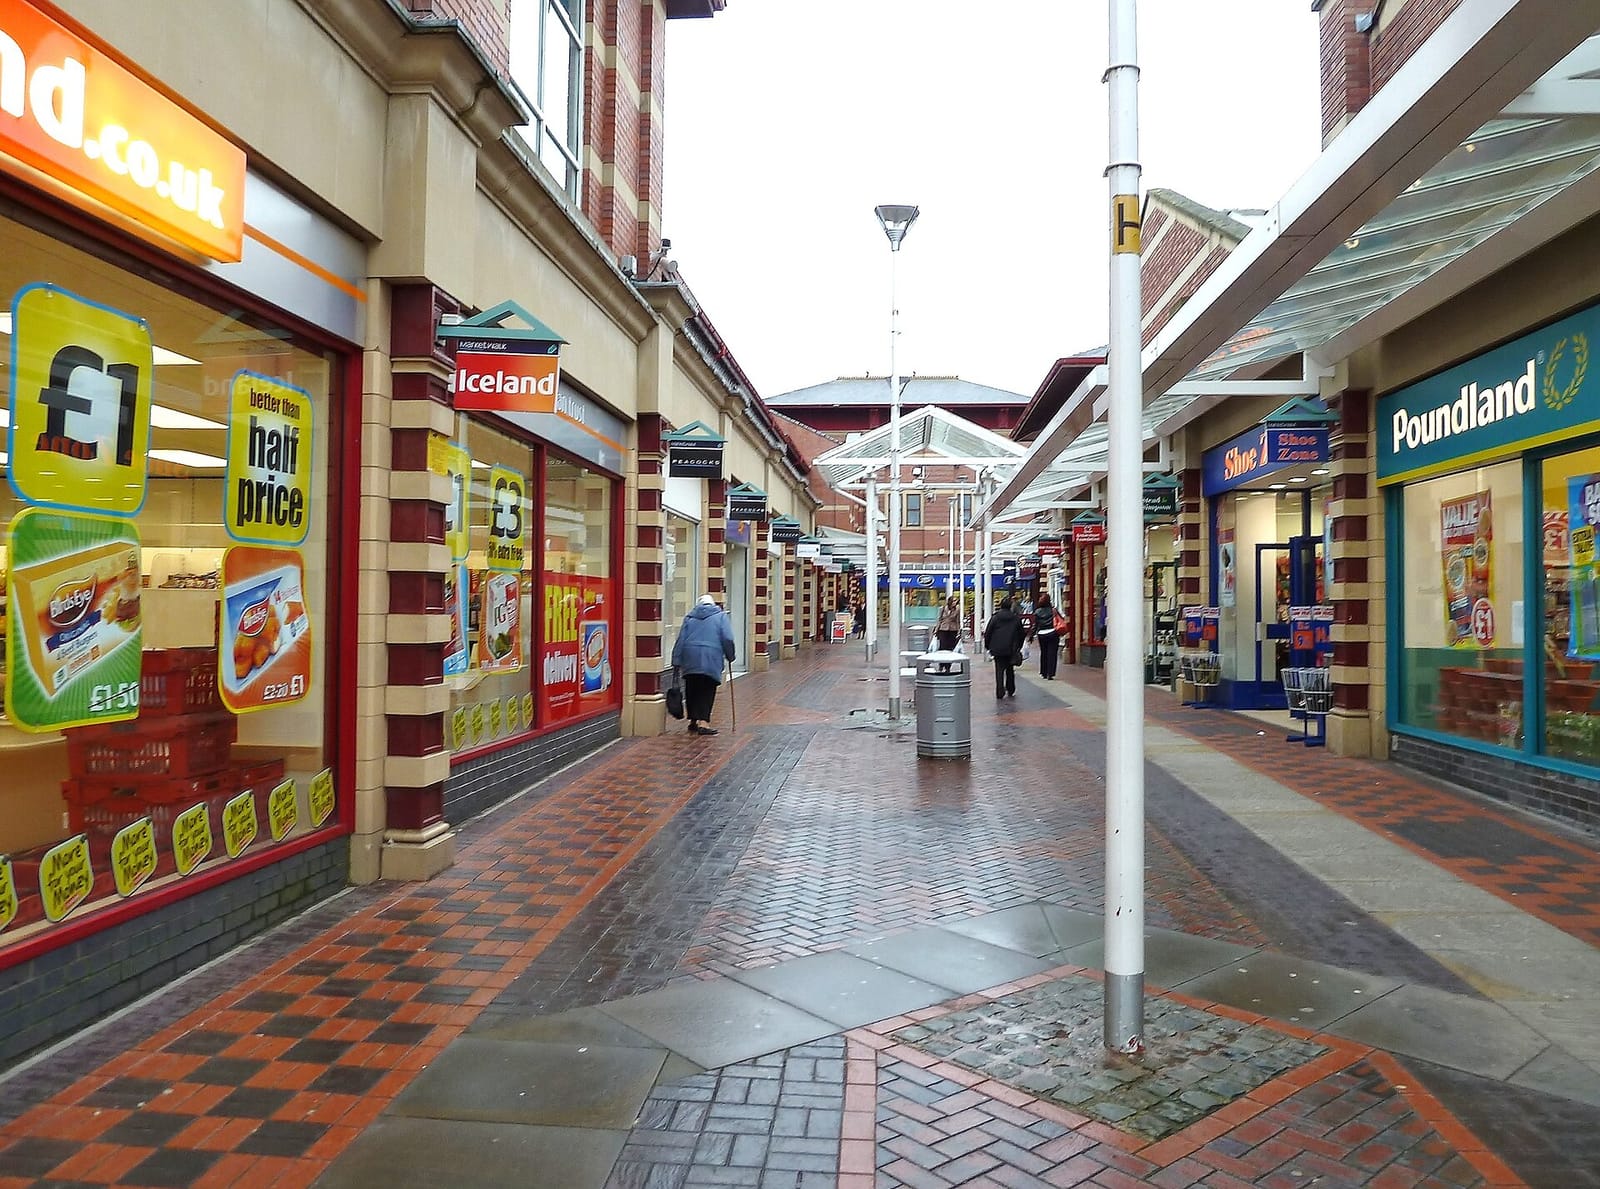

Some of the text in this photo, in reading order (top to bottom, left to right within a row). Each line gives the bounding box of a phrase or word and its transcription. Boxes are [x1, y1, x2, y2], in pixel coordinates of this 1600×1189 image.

[459, 368, 556, 396] Iceland
[35, 344, 139, 467] £1
[250, 387, 300, 420] better than
[1392, 358, 1537, 454] Poundland
[249, 415, 300, 475] half
[1277, 447, 1320, 461] Zone
[1278, 433, 1318, 446] Shoe
[1224, 446, 1258, 480] Shoe
[236, 473, 304, 527] price
[491, 477, 522, 540] £3
[544, 584, 578, 644] FREE
[290, 674, 304, 697] £1
[543, 650, 578, 686] delivery
